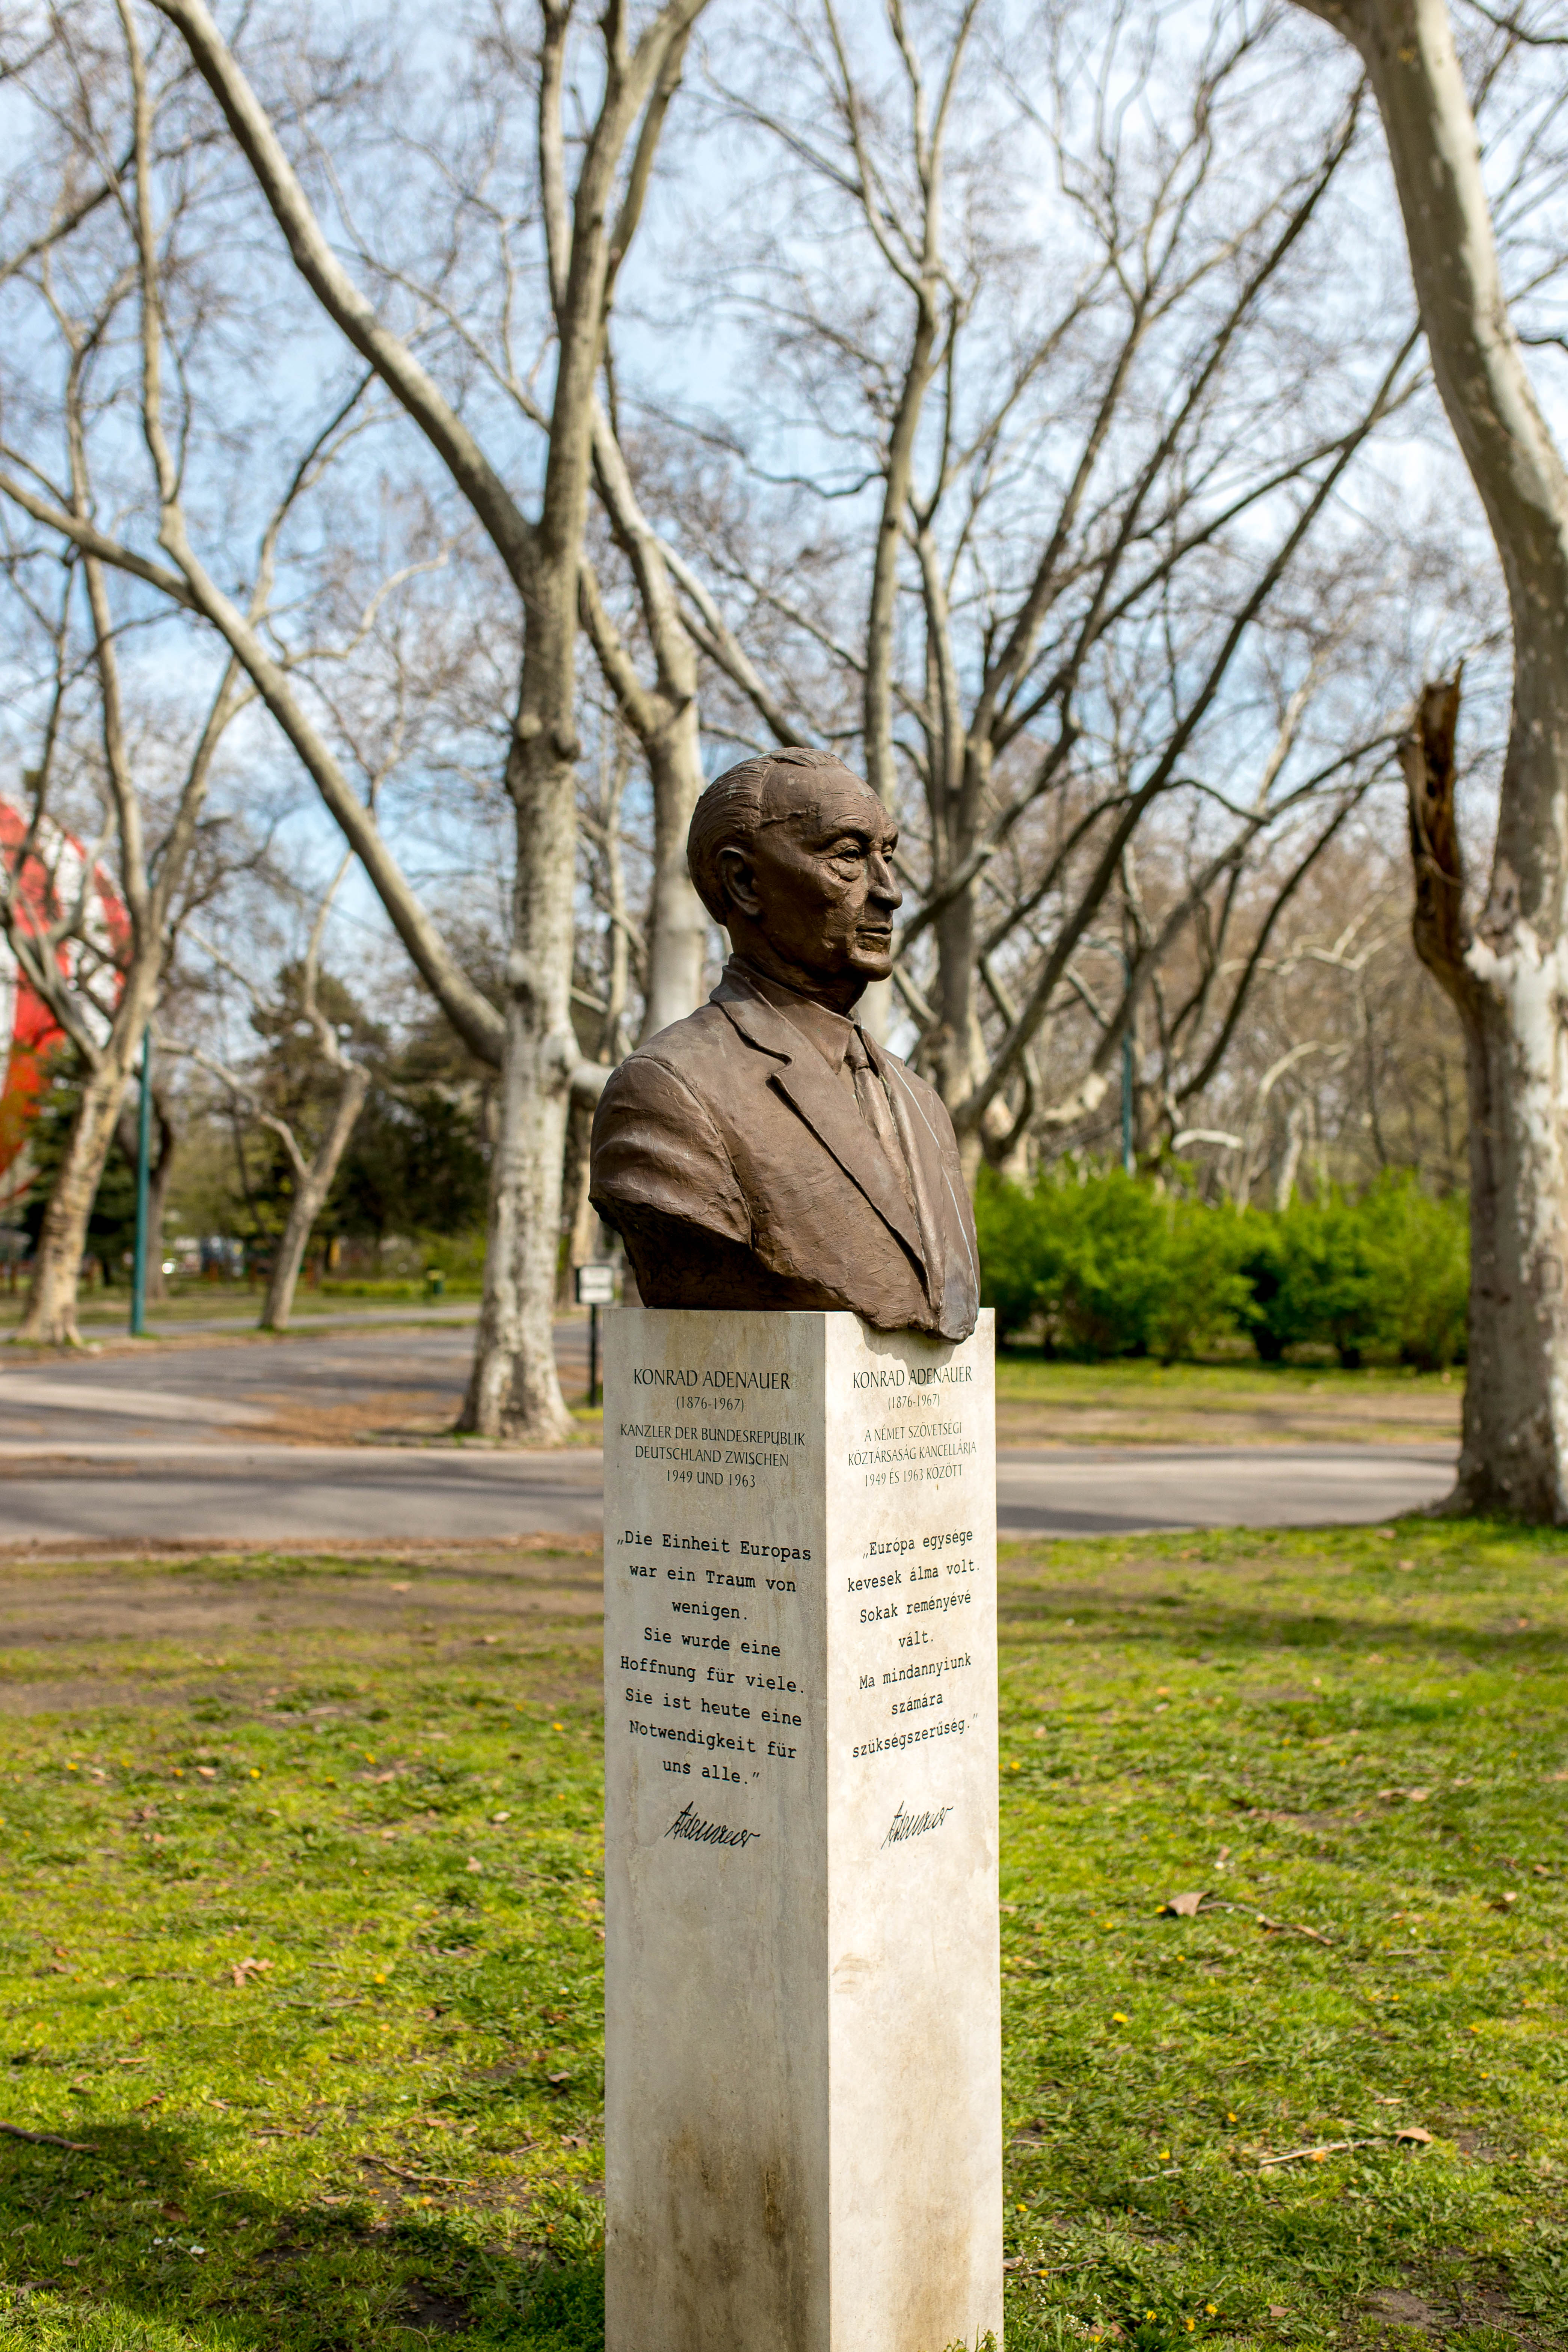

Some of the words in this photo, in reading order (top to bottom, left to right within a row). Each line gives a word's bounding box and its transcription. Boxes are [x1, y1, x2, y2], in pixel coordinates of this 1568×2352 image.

[634, 1369, 697, 1386] KONRAD
[703, 1371, 790, 1389] ADENAUER
[853, 1370, 904, 1388] KONRAD
[909, 1366, 972, 1385] ADENAUER
[676, 1396, 744, 1412] (1876-1967)
[888, 1393, 940, 1410] (1876-1967)
[621, 1424, 671, 1438] KANZLER
[675, 1427, 697, 1440] DER
[702, 1428, 805, 1446] BUNDESREPUBLIK
[865, 1430, 871, 1442] A
[874, 1424, 905, 1441] NÉMET
[908, 1419, 961, 1438] SZÖVETSÉGI
[635, 1446, 721, 1463] DEUTSCHLAND
[725, 1451, 788, 1466] ZWISCHEN
[848, 1444, 916, 1466] KÖZTÁRSASÁG
[919, 1439, 976, 1458] KANCELLÁRJA
[667, 1470, 692, 1483] 1949
[697, 1472, 723, 1485] UND
[729, 1474, 755, 1487] 1963
[866, 1473, 886, 1486] 1949
[889, 1468, 899, 1484] ÉS
[904, 1469, 924, 1482] 1963
[927, 1463, 963, 1479] KÖZÖTT
[662, 1534, 730, 1552] Einheit
[740, 1541, 811, 1562] Europas
[923, 1529, 973, 1550] egysége
[629, 1565, 657, 1577] war
[667, 1567, 695, 1581] ein
[706, 1570, 756, 1588] Traum
[765, 1579, 796, 1592] von
[848, 1570, 901, 1592] kevesek
[910, 1567, 939, 1581] álma
[946, 1559, 979, 1575] volt.
[672, 1601, 747, 1620] wenigen.
[860, 1603, 898, 1623] Sokak
[907, 1590, 971, 1614] reményévé
[644, 1627, 671, 1642] Sie
[682, 1634, 730, 1650] wurde
[741, 1640, 781, 1656] eine
[899, 1631, 933, 1647] vált.
[621, 1656, 696, 1682] Hoffnung
[707, 1667, 735, 1683] für
[746, 1673, 804, 1693] viele.
[860, 1675, 875, 1689] Ma
[883, 1653, 971, 1684] mindannyiunk
[626, 1688, 652, 1704] Sie
[663, 1693, 691, 1710] ist
[701, 1698, 750, 1718] heute
[761, 1709, 802, 1726] eine
[892, 1693, 943, 1715] számára
[629, 1720, 756, 1753] Notwendigkeit
[768, 1741, 797, 1759] für
[663, 1760, 690, 1774] uns
